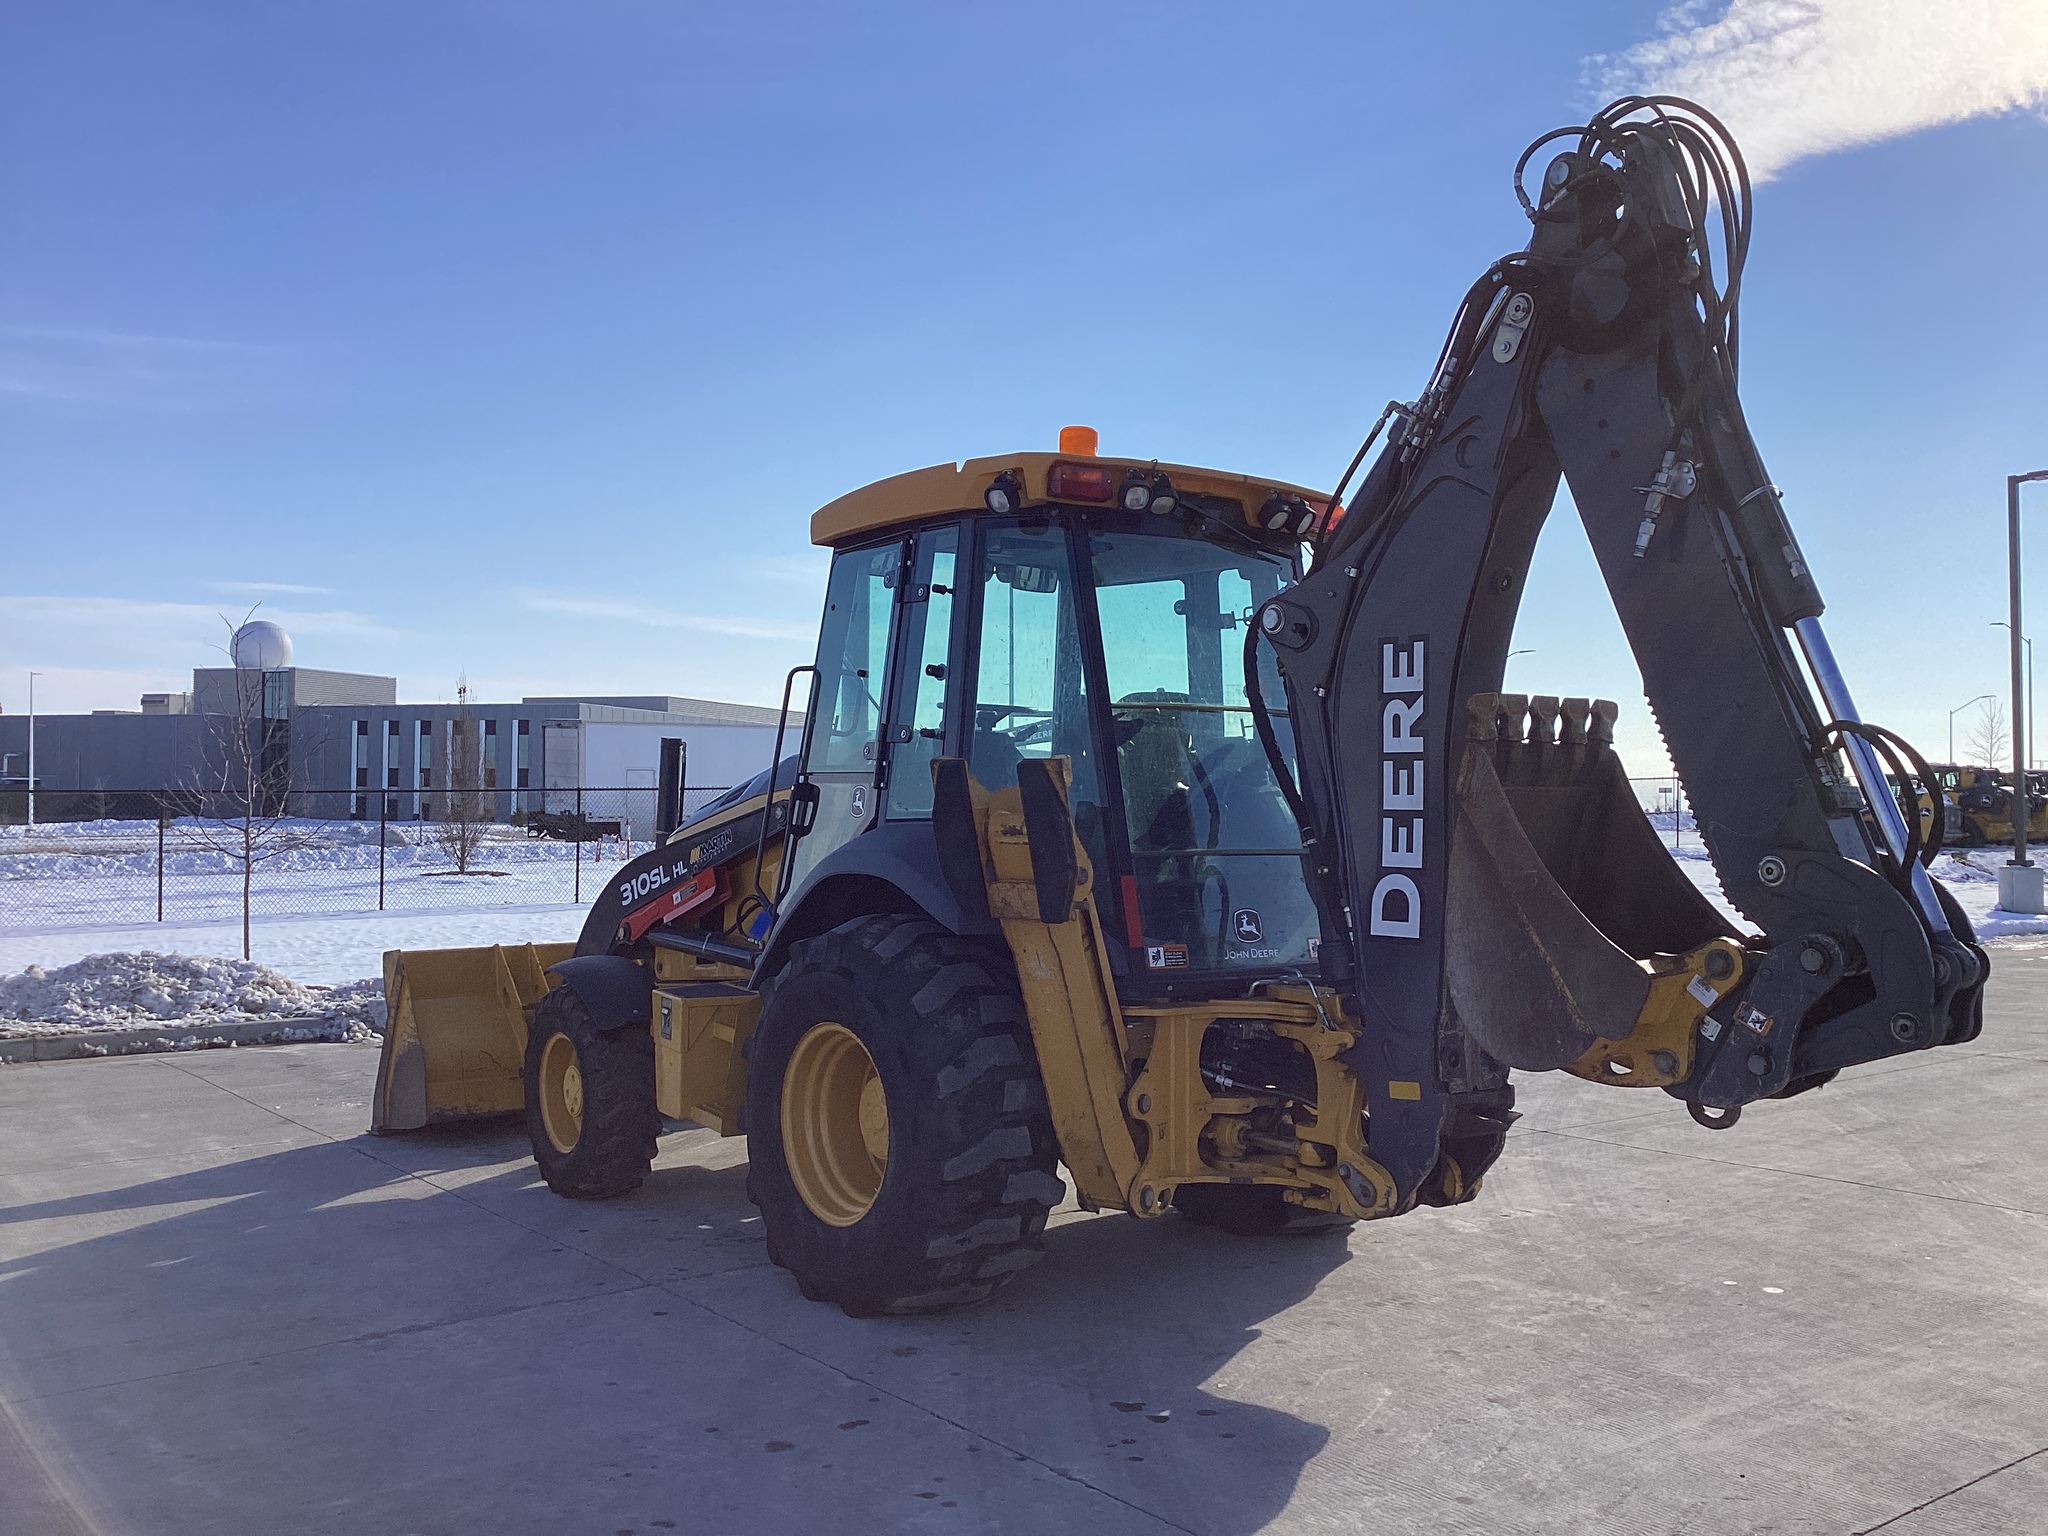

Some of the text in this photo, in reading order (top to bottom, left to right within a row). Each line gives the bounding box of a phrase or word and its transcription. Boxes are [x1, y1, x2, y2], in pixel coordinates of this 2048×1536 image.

[1370, 641, 1424, 939] DEERE
[699, 829, 733, 858] MARTIN
[620, 865, 671, 906] 310SL
[672, 860, 688, 878] HL
[1224, 948, 1279, 960] JOHN DEERE
